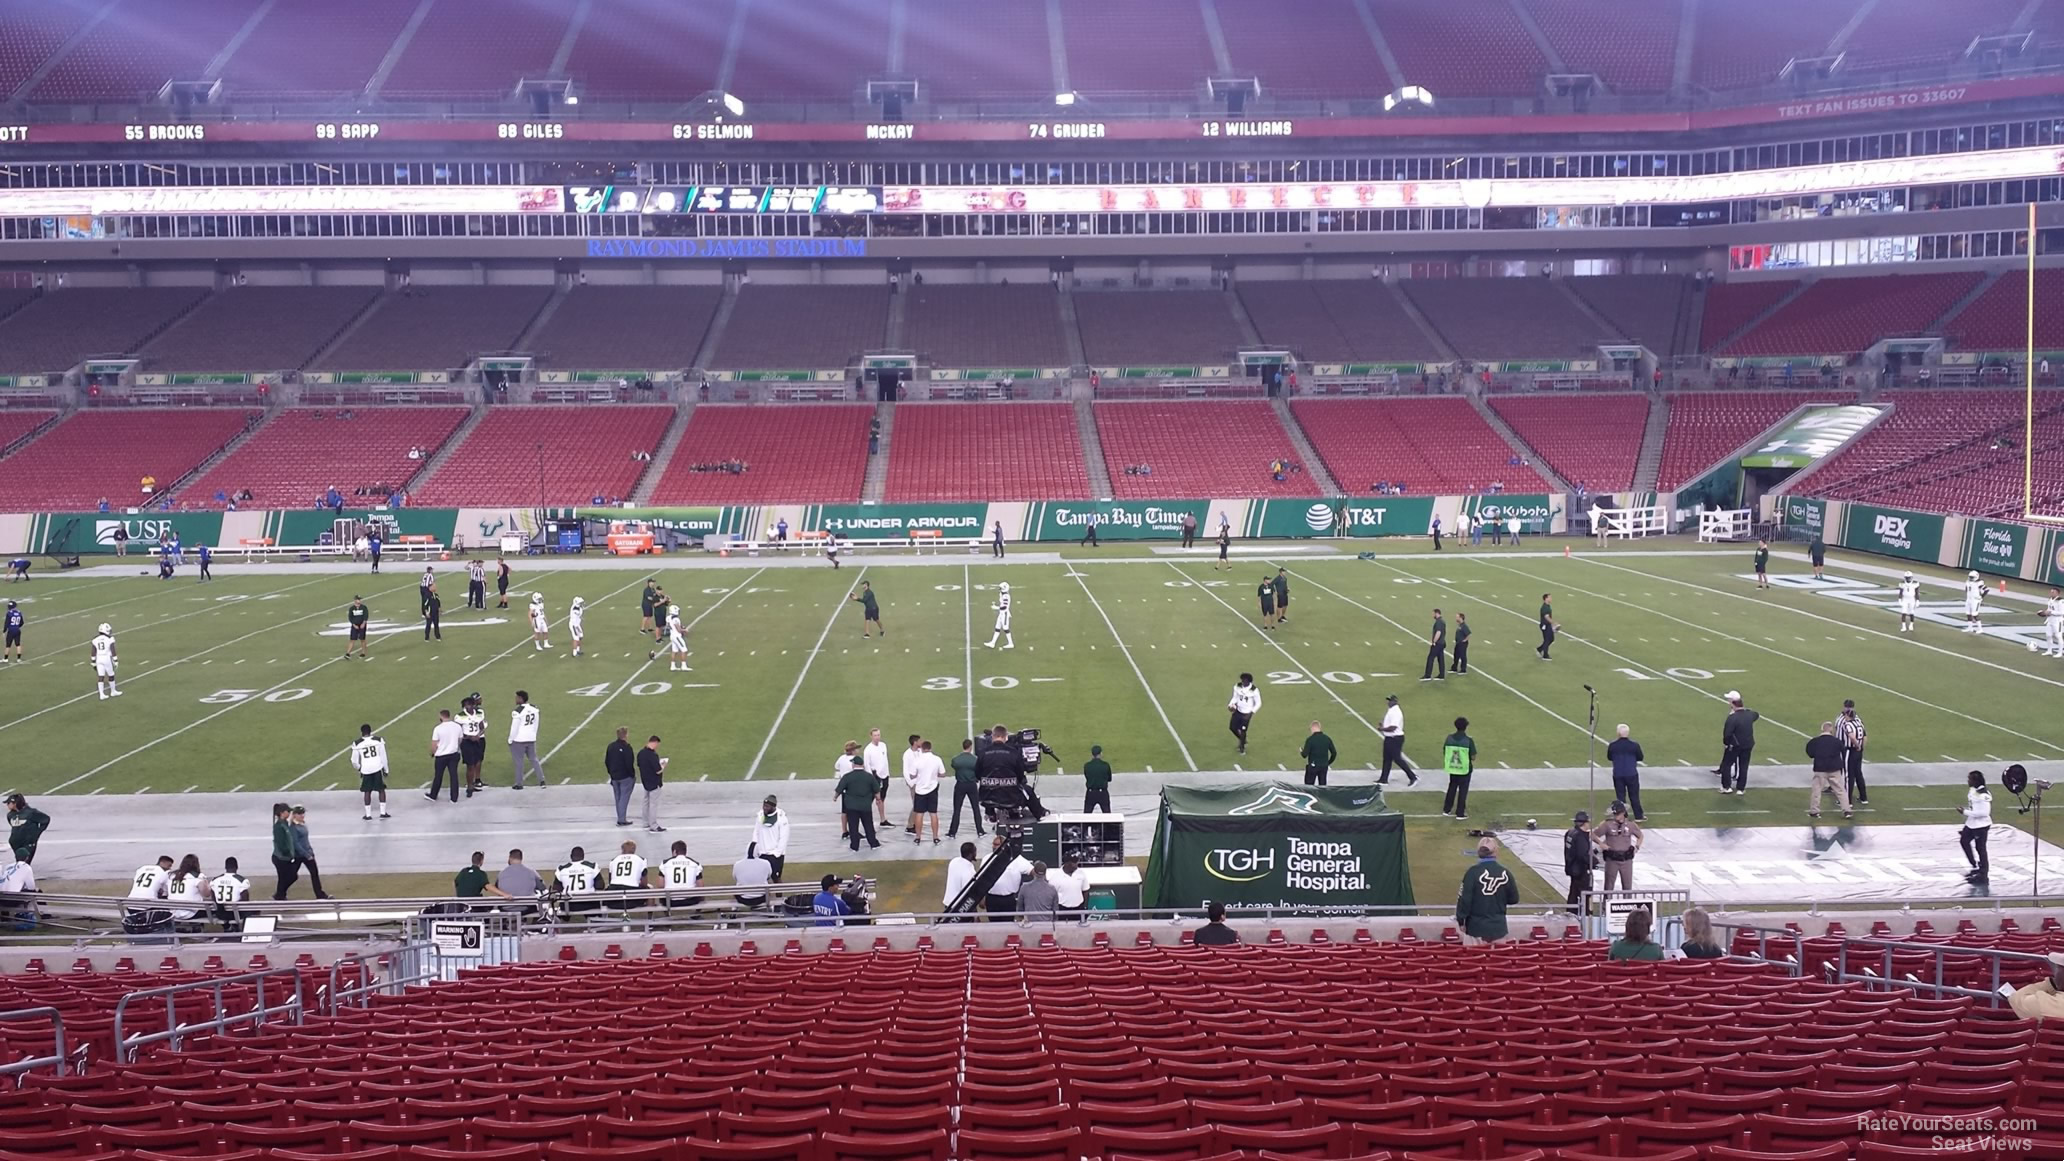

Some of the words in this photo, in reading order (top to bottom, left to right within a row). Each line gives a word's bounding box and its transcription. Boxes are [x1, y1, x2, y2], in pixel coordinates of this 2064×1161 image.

[1778, 103, 1812, 118] TEXT
[1815, 101, 1843, 113] FAN
[1846, 96, 1895, 111] ISSUES
[1898, 93, 1919, 105] TO
[1921, 87, 1967, 103] 33607
[125, 125, 144, 140] 55
[149, 125, 204, 140] BROOKS
[316, 124, 336, 139] 99
[341, 124, 380, 139] SAPP
[498, 123, 519, 138] 88
[523, 123, 563, 138] GILES
[673, 124, 692, 138] 63
[697, 124, 753, 139] SELMON
[1029, 123, 1048, 138] 74
[1053, 123, 1105, 138] GRUBER
[1202, 122, 1219, 137] 12
[1225, 121, 1292, 136] WILLIAMS
[587, 239, 697, 257] RAYMOND
[701, 239, 769, 257] JAMES
[774, 239, 866, 257] STADIUM
[1111, 507, 1143, 528] Bay
[1503, 505, 1549, 517] Kubota
[122, 519, 172, 540] USF
[846, 518, 902, 529] UNDER
[1873, 514, 1910, 539] DEX
[1983, 527, 2012, 543] Florida
[1982, 541, 1999, 554] Blue
[10, 616, 21, 626] 90
[1266, 670, 1365, 685] 20
[1612, 666, 1716, 681] 10
[566, 681, 673, 697] 40
[920, 675, 1020, 690] 30
[199, 688, 313, 703] 50
[468, 721, 479, 733] 35
[524, 713, 535, 727] 92
[362, 745, 377, 759] 28
[980, 777, 1017, 786] CHAPMAN
[1286, 836, 1352, 859] Tampa
[1213, 847, 1275, 871] TGH
[1286, 853, 1361, 874] General
[615, 860, 633, 877] 69
[673, 866, 687, 884] 61
[135, 872, 156, 888] 45
[568, 873, 586, 891] 75
[217, 885, 233, 902] 33
[1611, 903, 1638, 911] WARNING
[437, 926, 464, 934] WARNING
